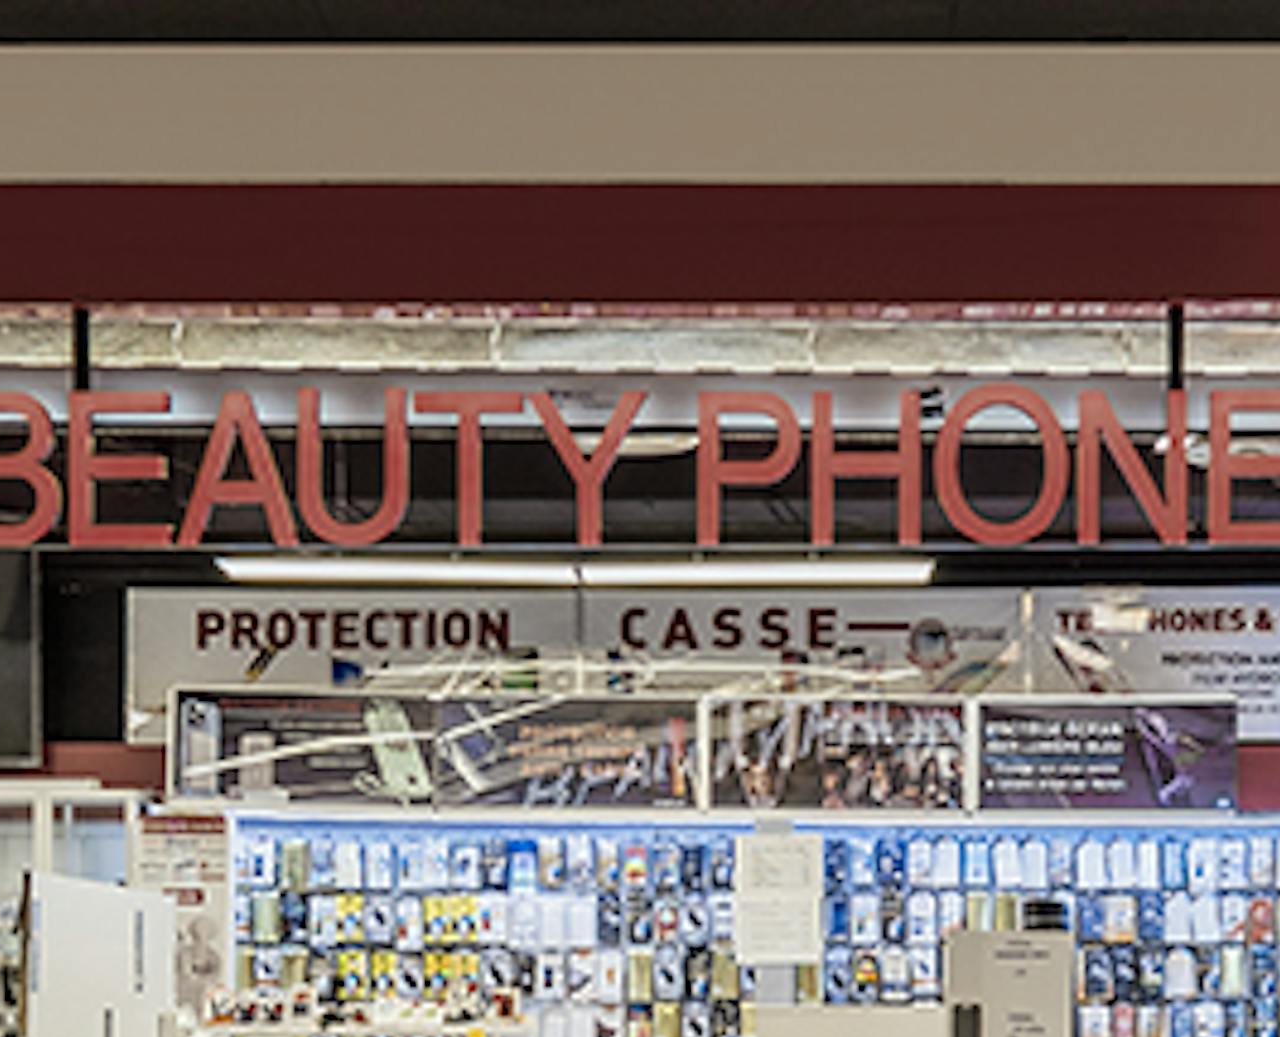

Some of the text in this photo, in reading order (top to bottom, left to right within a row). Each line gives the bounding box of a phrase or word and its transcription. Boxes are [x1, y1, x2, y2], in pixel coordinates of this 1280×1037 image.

[196, 607, 838, 651] PROTECTION CASSE
[1056, 608, 1246, 633] TEHONES
[1253, 607, 1273, 632] &
